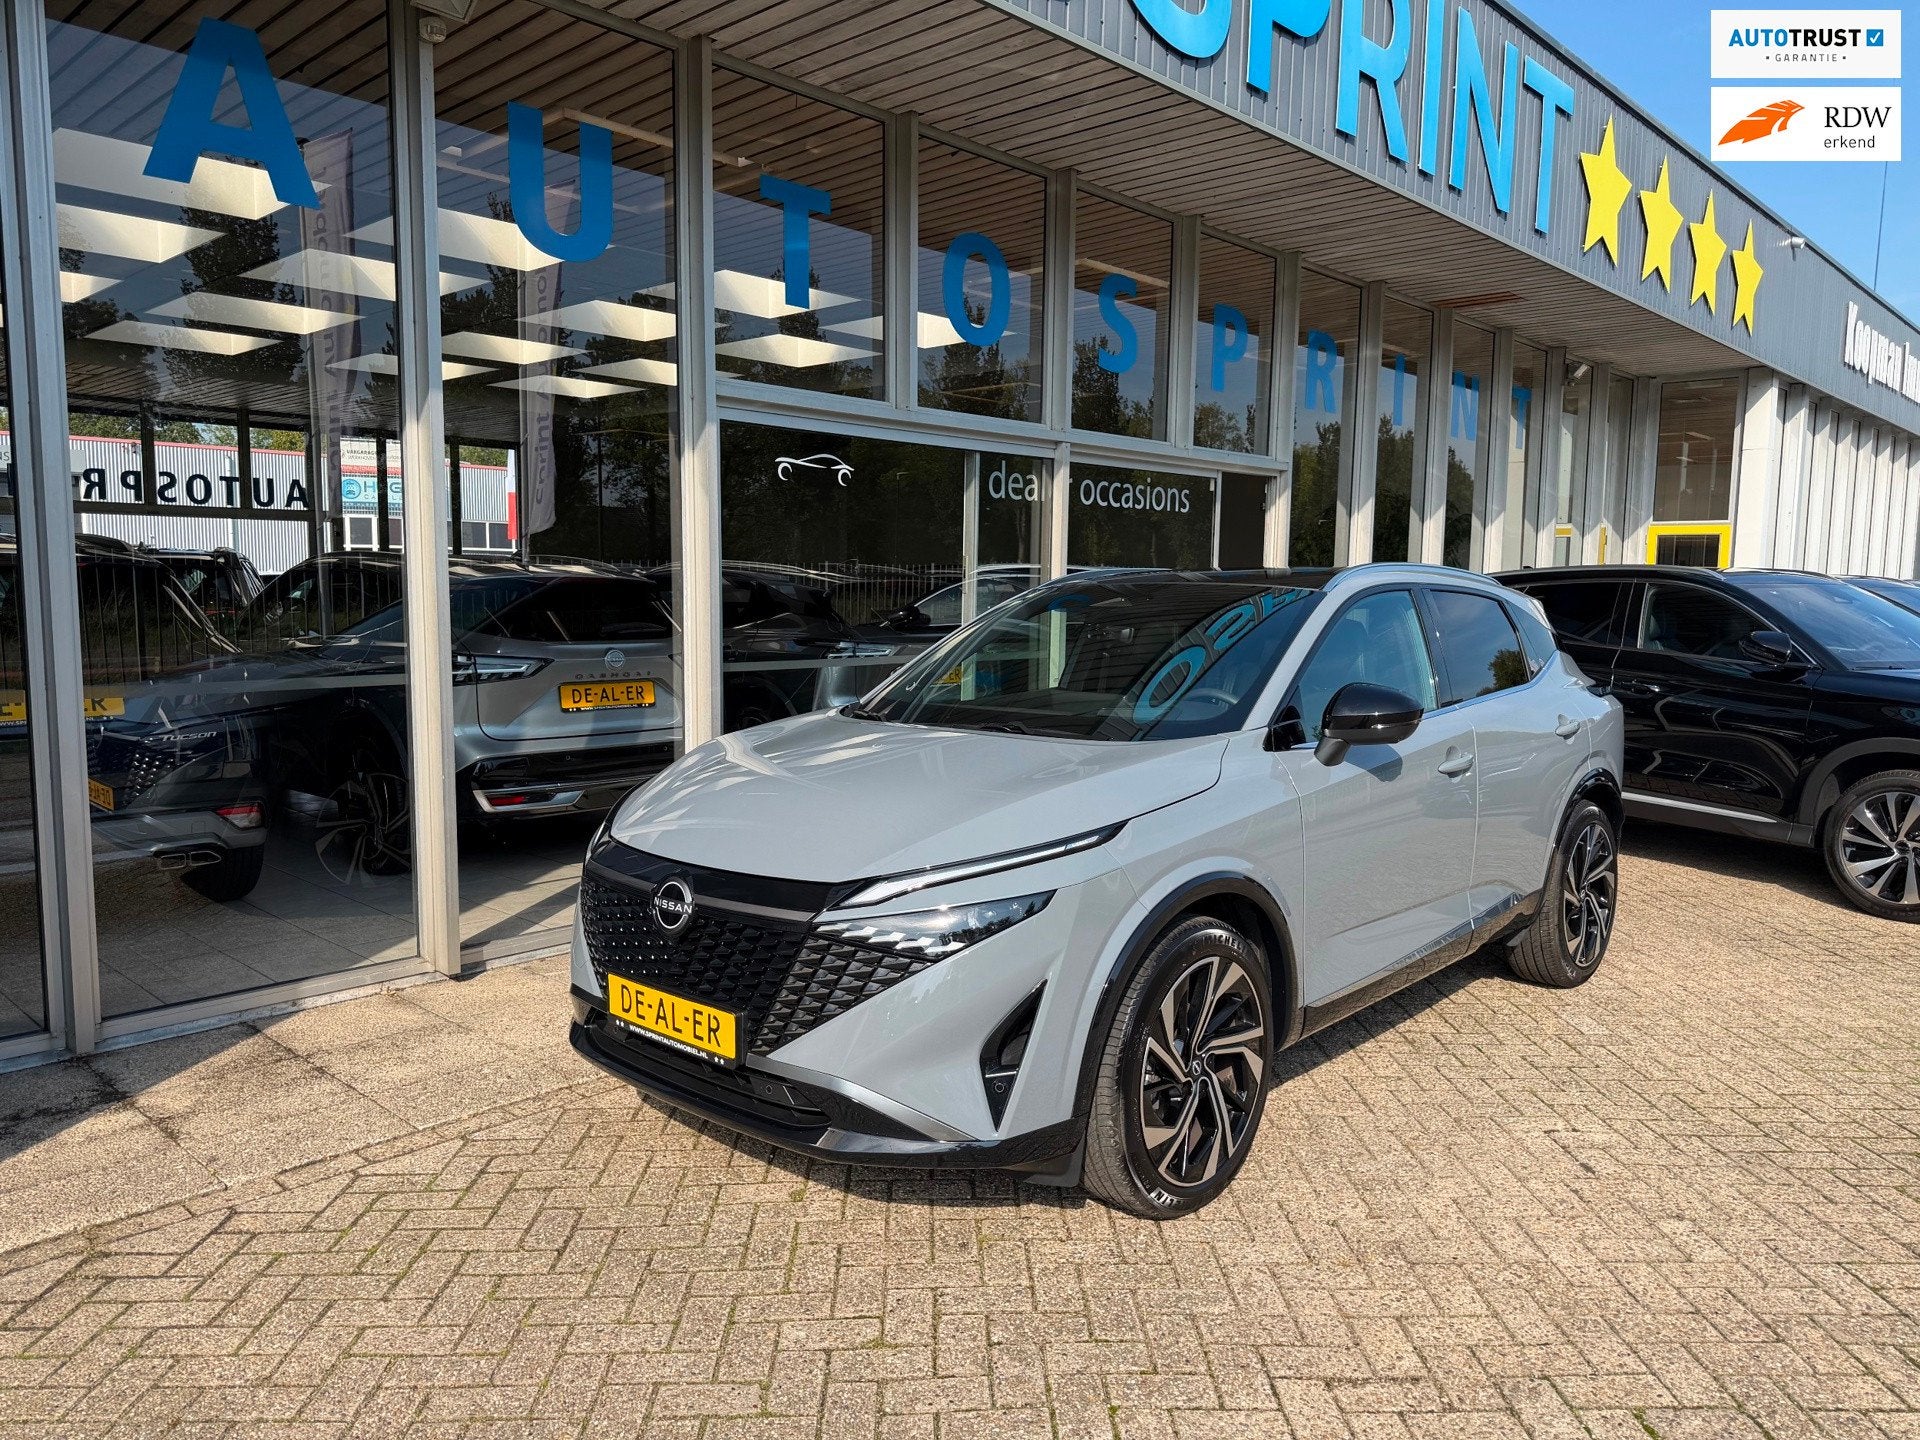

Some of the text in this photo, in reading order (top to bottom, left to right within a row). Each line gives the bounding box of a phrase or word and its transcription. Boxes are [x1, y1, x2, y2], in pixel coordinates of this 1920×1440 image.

[1079, 477, 1190, 513] occasions
[571, 685, 645, 704] DE-AL-ER
[653, 896, 693, 915] NISSAN
[620, 983, 722, 1048] DE-AL-ER
